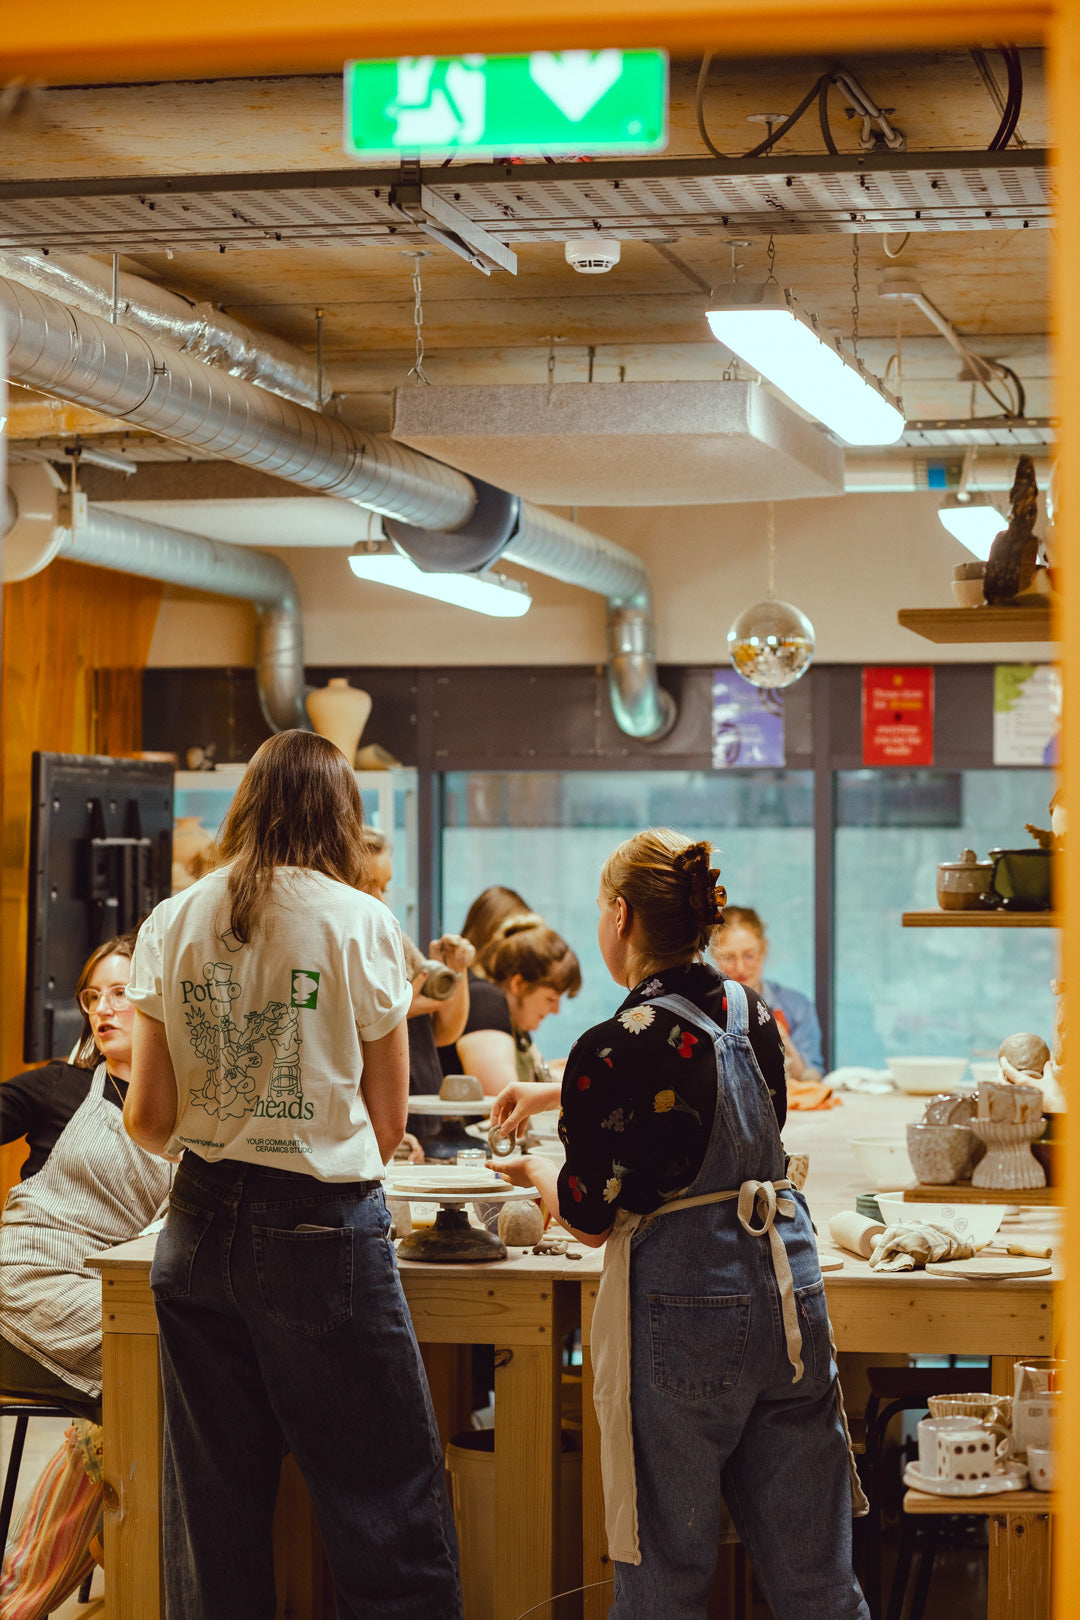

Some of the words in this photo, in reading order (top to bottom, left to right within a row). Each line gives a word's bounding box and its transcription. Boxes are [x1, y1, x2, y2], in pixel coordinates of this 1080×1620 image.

[180, 980, 217, 1004] Pot
[253, 1095, 314, 1120] heads
[265, 1138, 304, 1146] COMMUNITY
[290, 1146, 313, 1154] STUDIO
